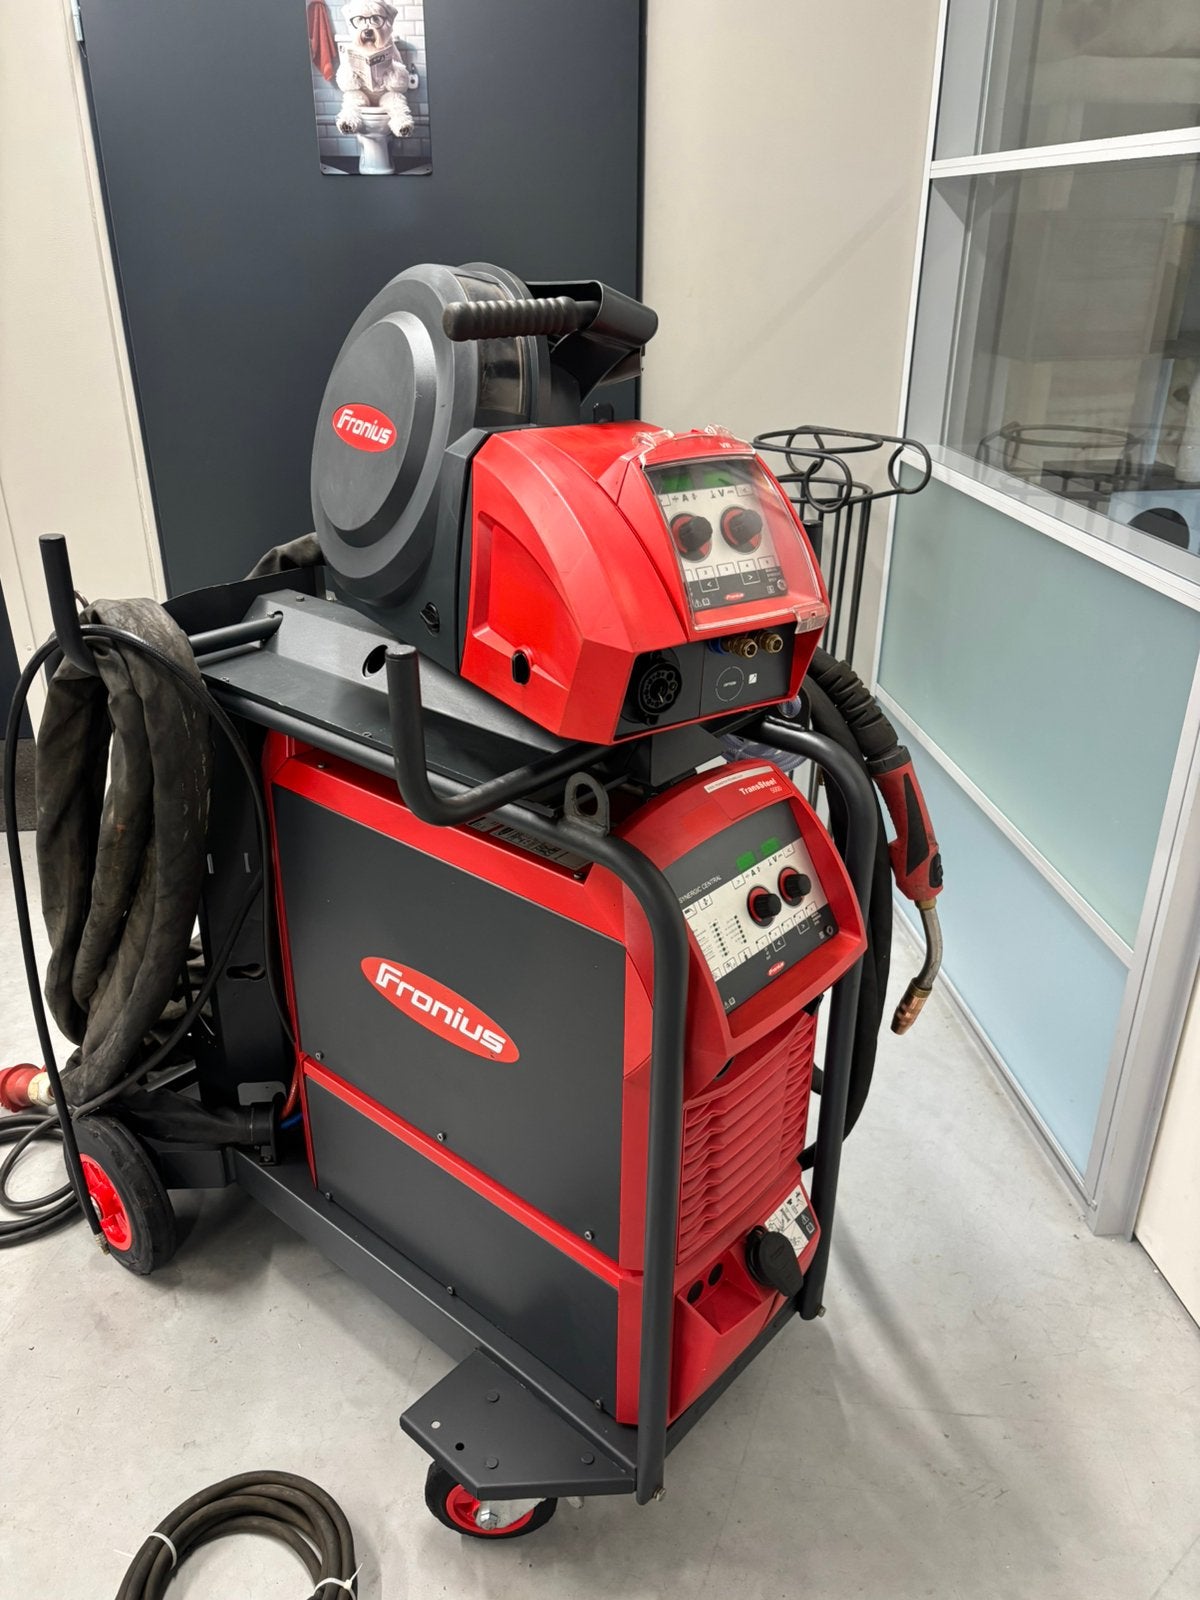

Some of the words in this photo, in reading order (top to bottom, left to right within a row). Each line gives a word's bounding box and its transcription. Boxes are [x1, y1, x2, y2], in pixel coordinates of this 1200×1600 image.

[337, 408, 392, 445] Fronius
[739, 778, 778, 795] TransSteel
[678, 885, 702, 904] SYNERGIC
[701, 875, 722, 891] CENTRAL
[375, 962, 506, 1054] Fronius
